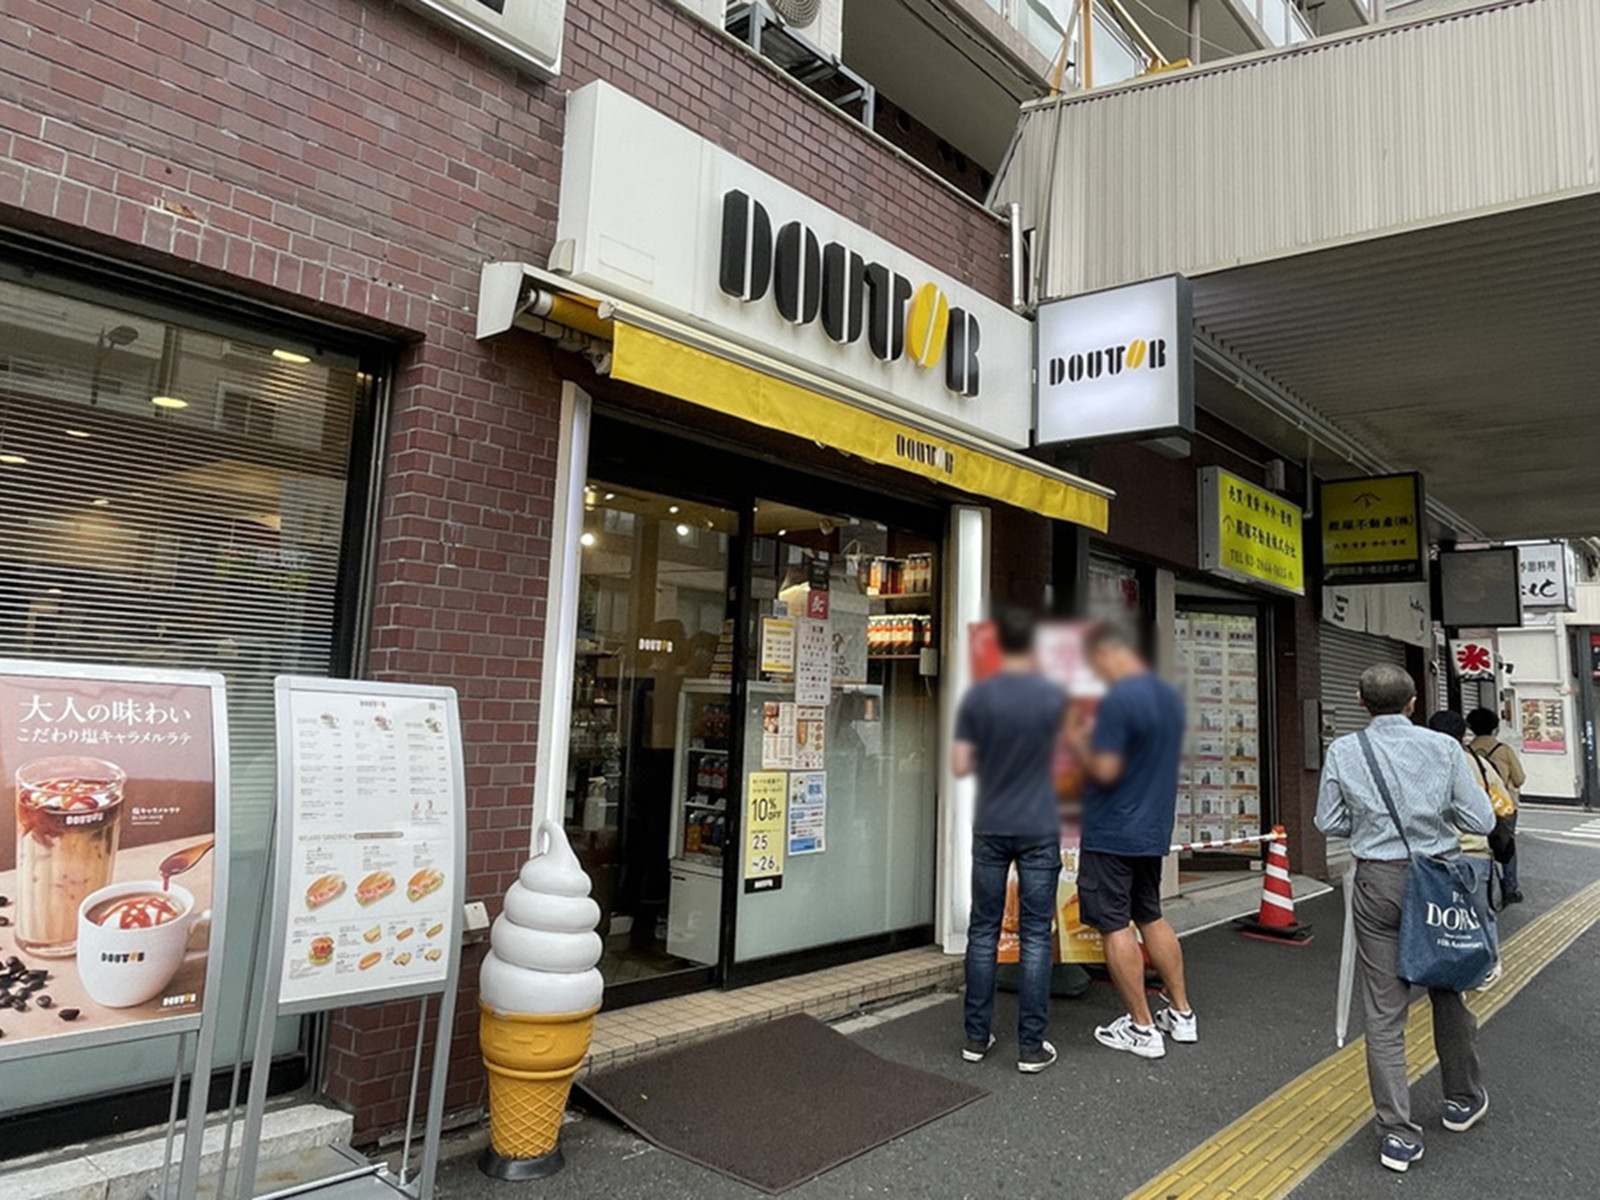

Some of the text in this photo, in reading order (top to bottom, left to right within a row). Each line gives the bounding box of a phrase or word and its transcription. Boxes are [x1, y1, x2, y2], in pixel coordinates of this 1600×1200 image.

[719, 189, 981, 397] DOUTOR
[1050, 339, 1166, 386] DOUTOR
[19, 694, 192, 726] 大人の味わい
[17, 728, 192, 746] こだわり塩キャラメルラテ
[752, 834, 768, 850] 25
